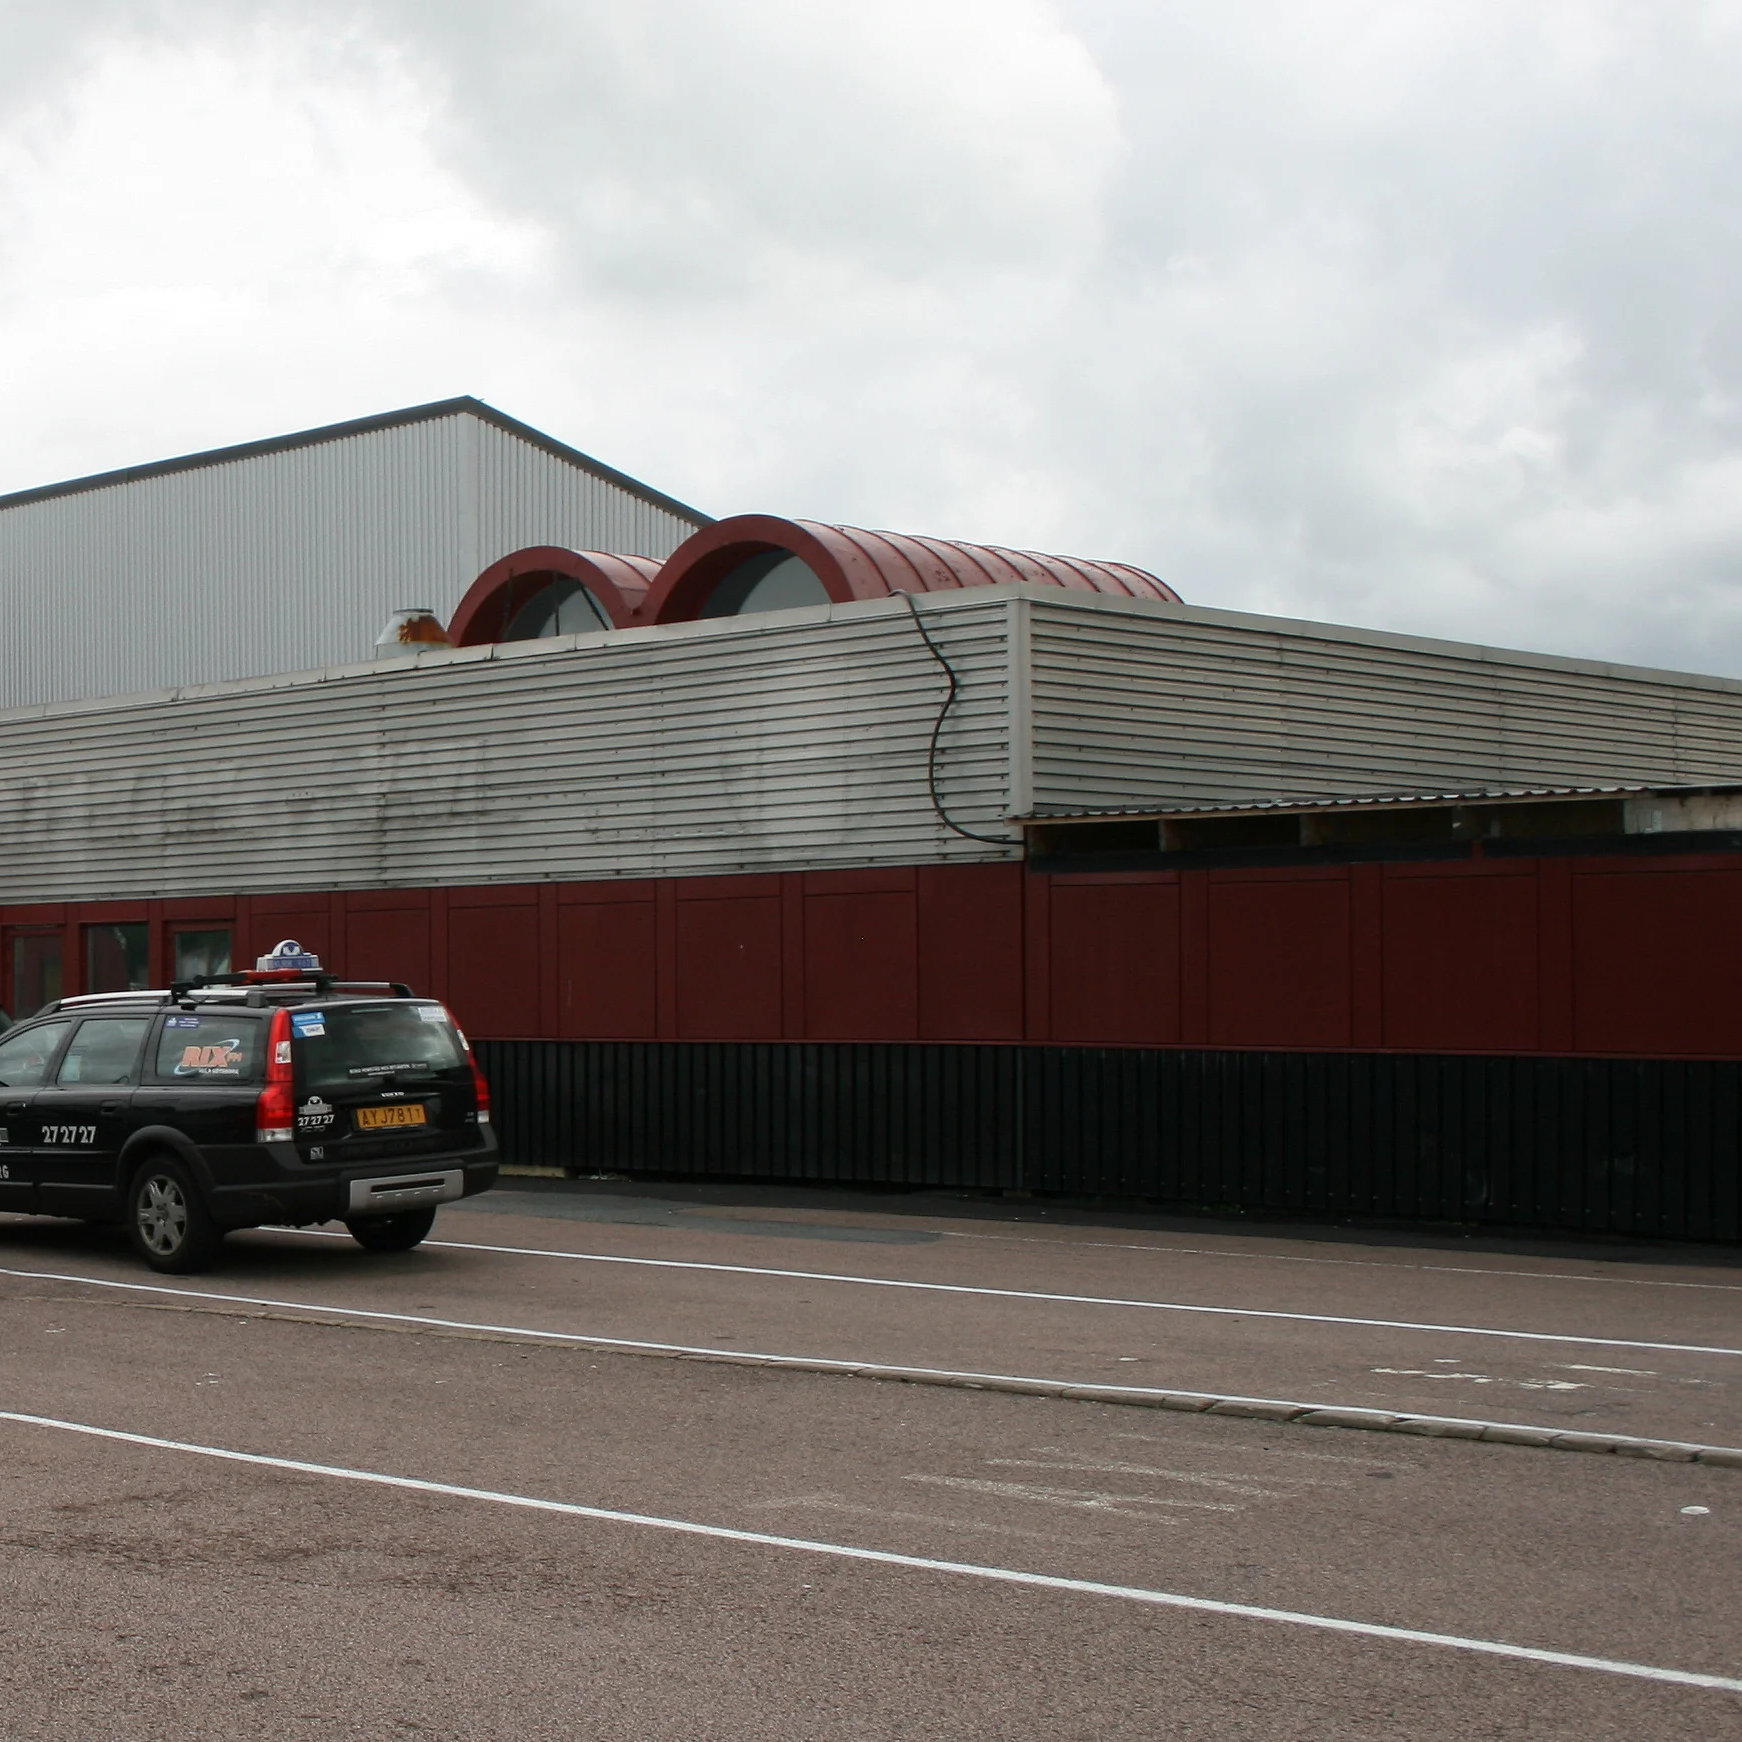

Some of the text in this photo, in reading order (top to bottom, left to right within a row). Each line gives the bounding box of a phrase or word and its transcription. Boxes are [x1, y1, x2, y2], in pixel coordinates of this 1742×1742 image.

[181, 1045, 232, 1069] RIX
[297, 1114, 335, 1127] 27 27 27
[41, 1125, 97, 1144] 27 27 27
